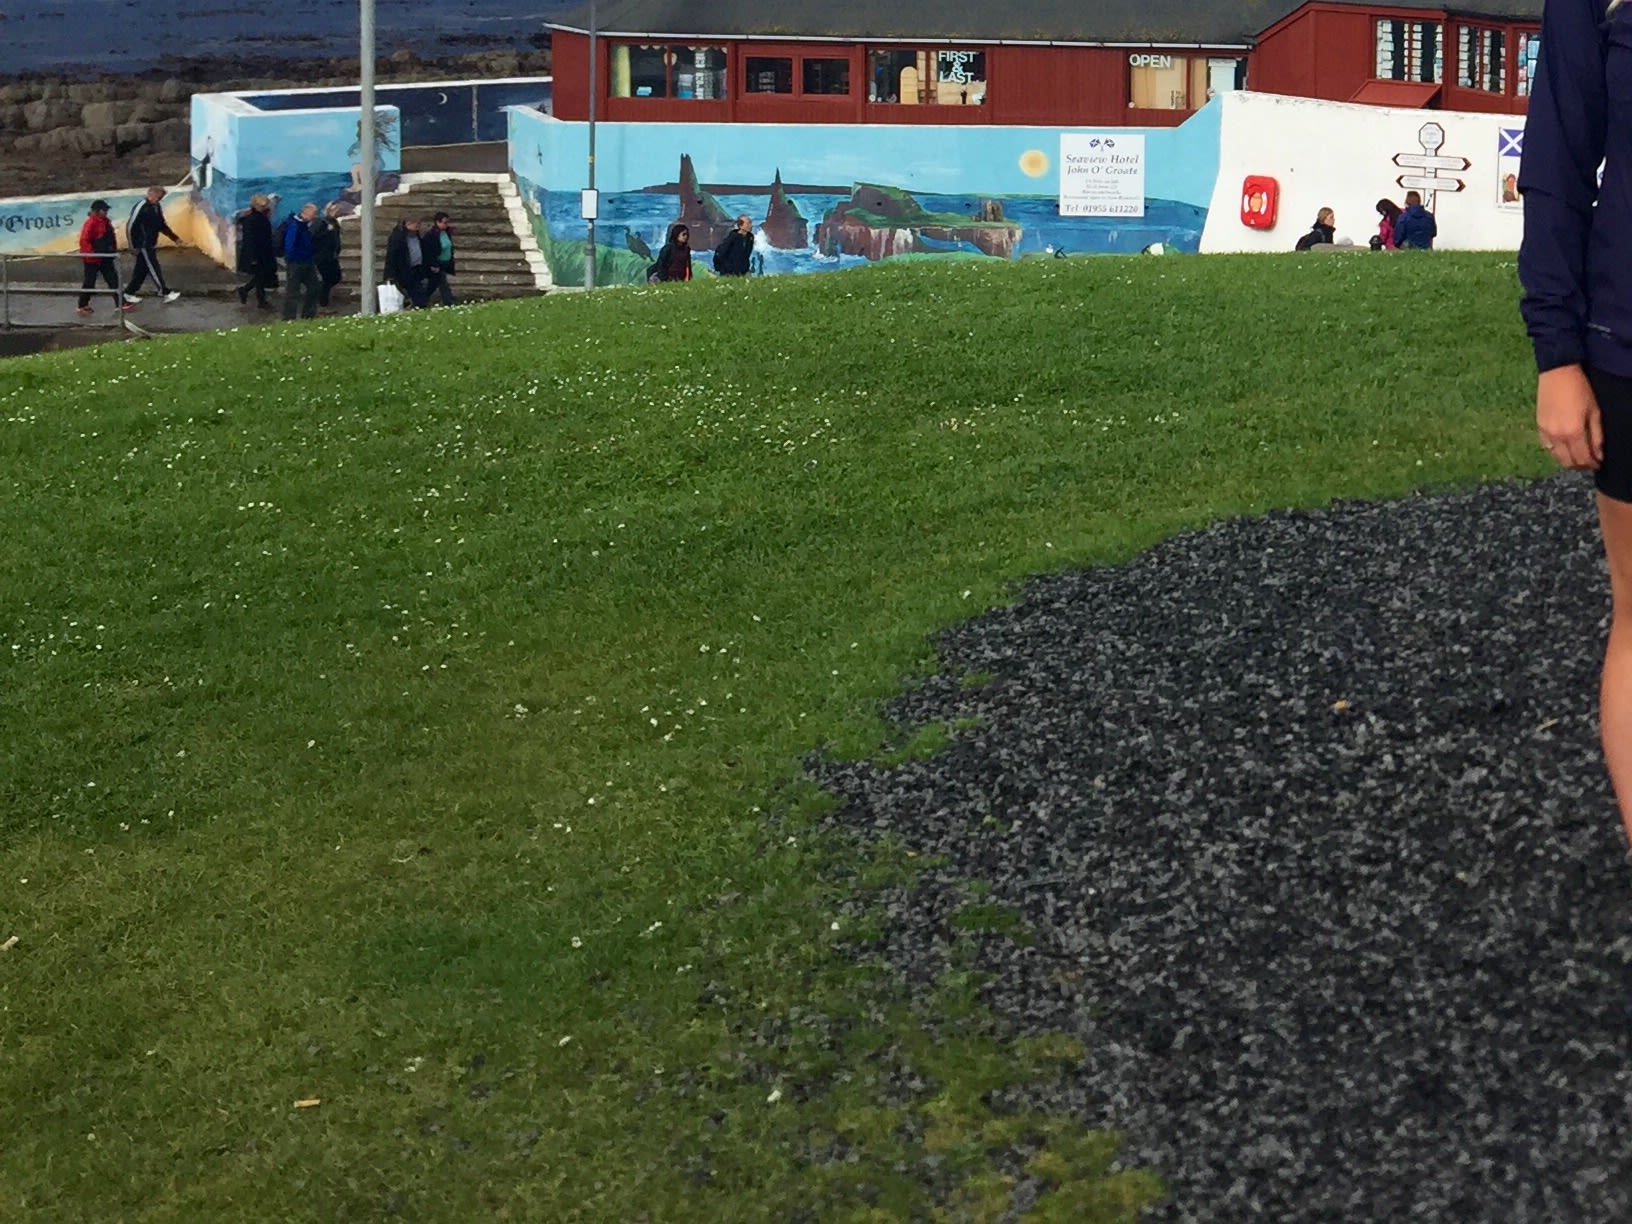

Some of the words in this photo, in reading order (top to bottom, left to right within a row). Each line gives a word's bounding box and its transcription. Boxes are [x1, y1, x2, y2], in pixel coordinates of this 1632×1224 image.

[938, 50, 976, 63] FIRST
[1129, 54, 1171, 68] OPEN
[952, 61, 964, 74] &
[939, 71, 975, 83] LAST
[1065, 154, 1108, 164] Seaview
[1111, 154, 1139, 164] Hotel
[1067, 165, 1089, 175] John
